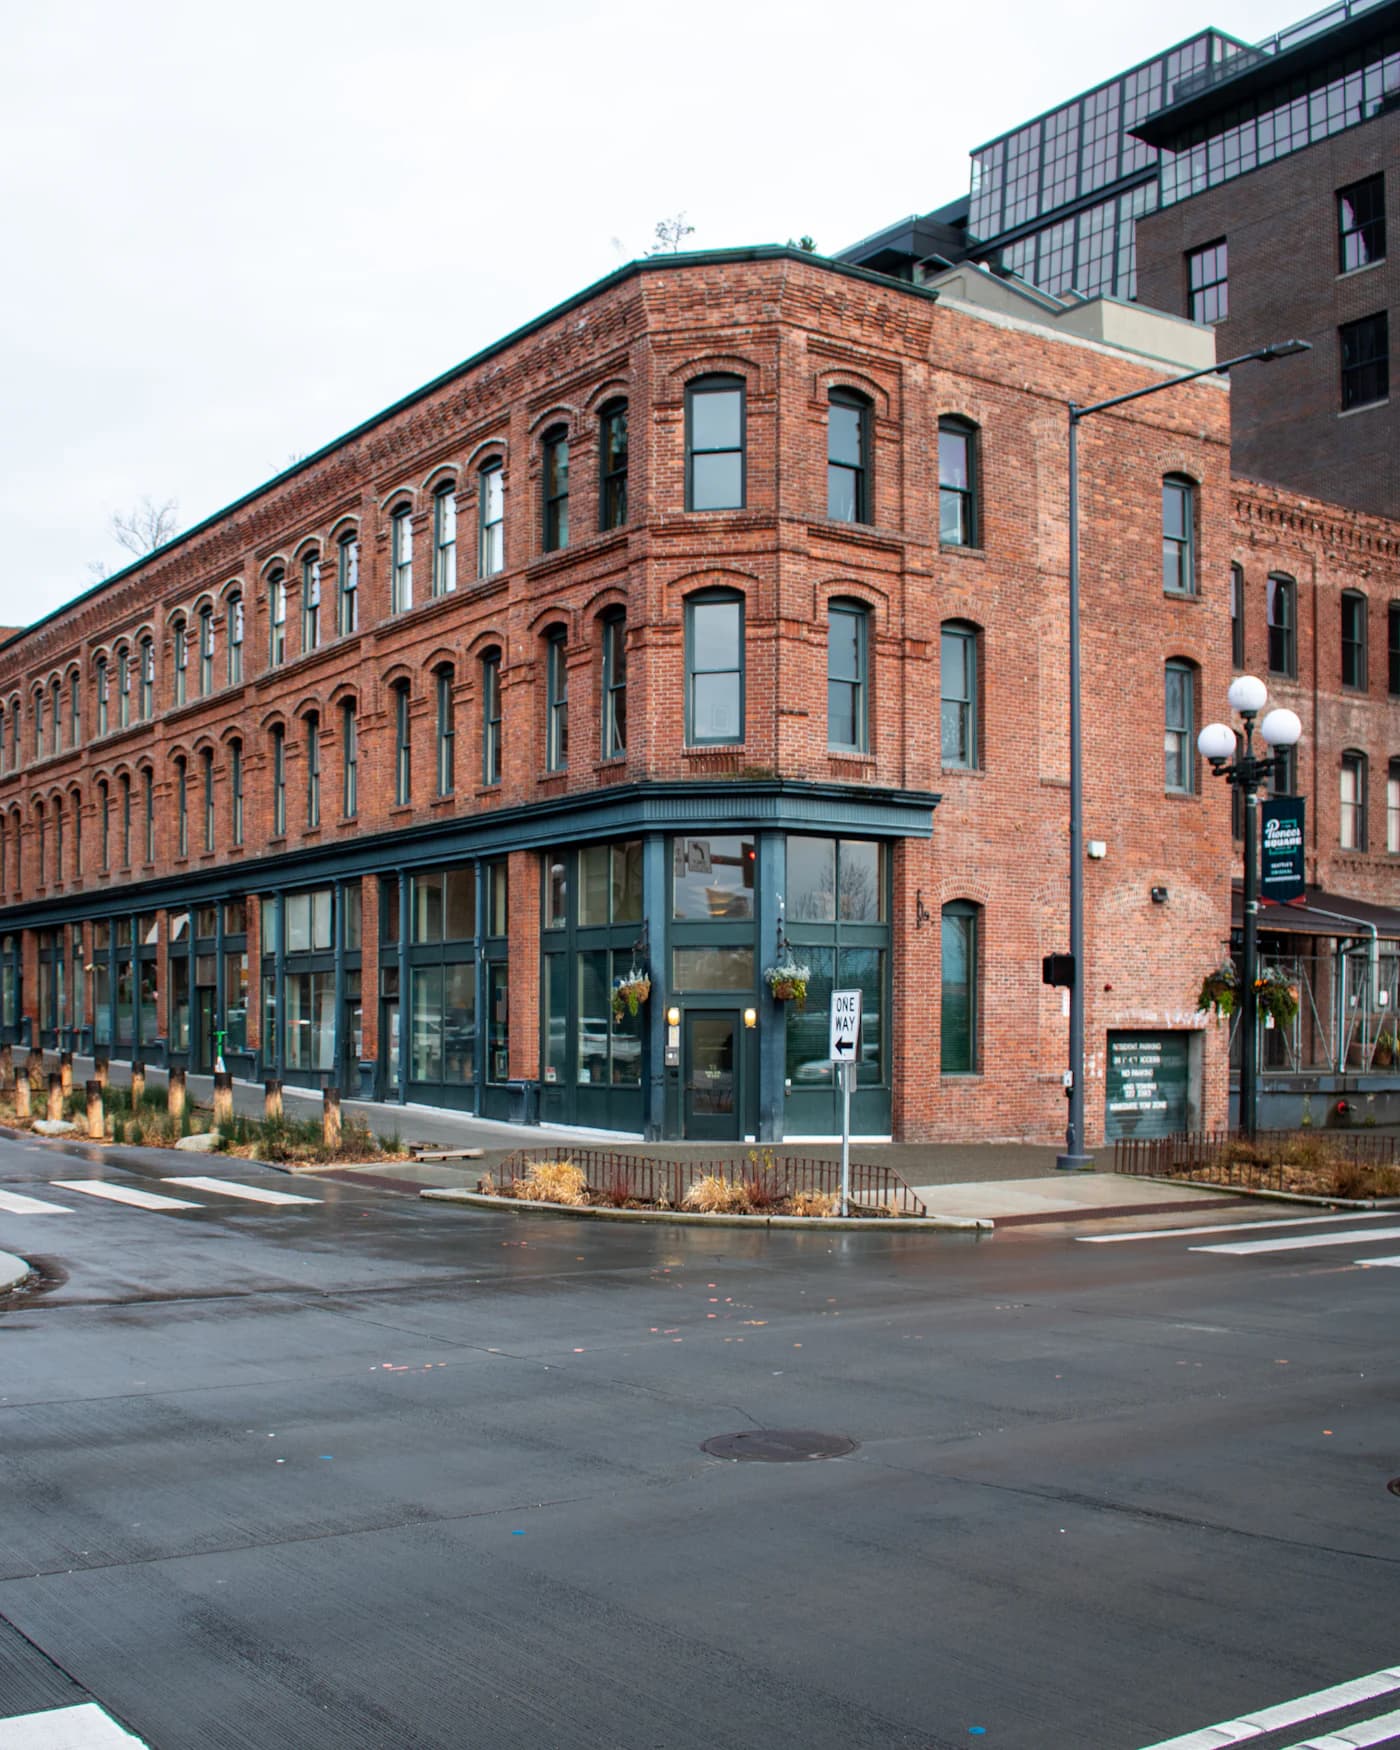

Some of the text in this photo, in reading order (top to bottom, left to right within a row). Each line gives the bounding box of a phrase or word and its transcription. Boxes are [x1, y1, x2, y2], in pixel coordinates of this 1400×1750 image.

[1265, 818, 1301, 838] Pioneer
[1264, 838, 1302, 848] SQUARE
[836, 997, 855, 1012] ONE
[835, 1016, 855, 1031] WAY
